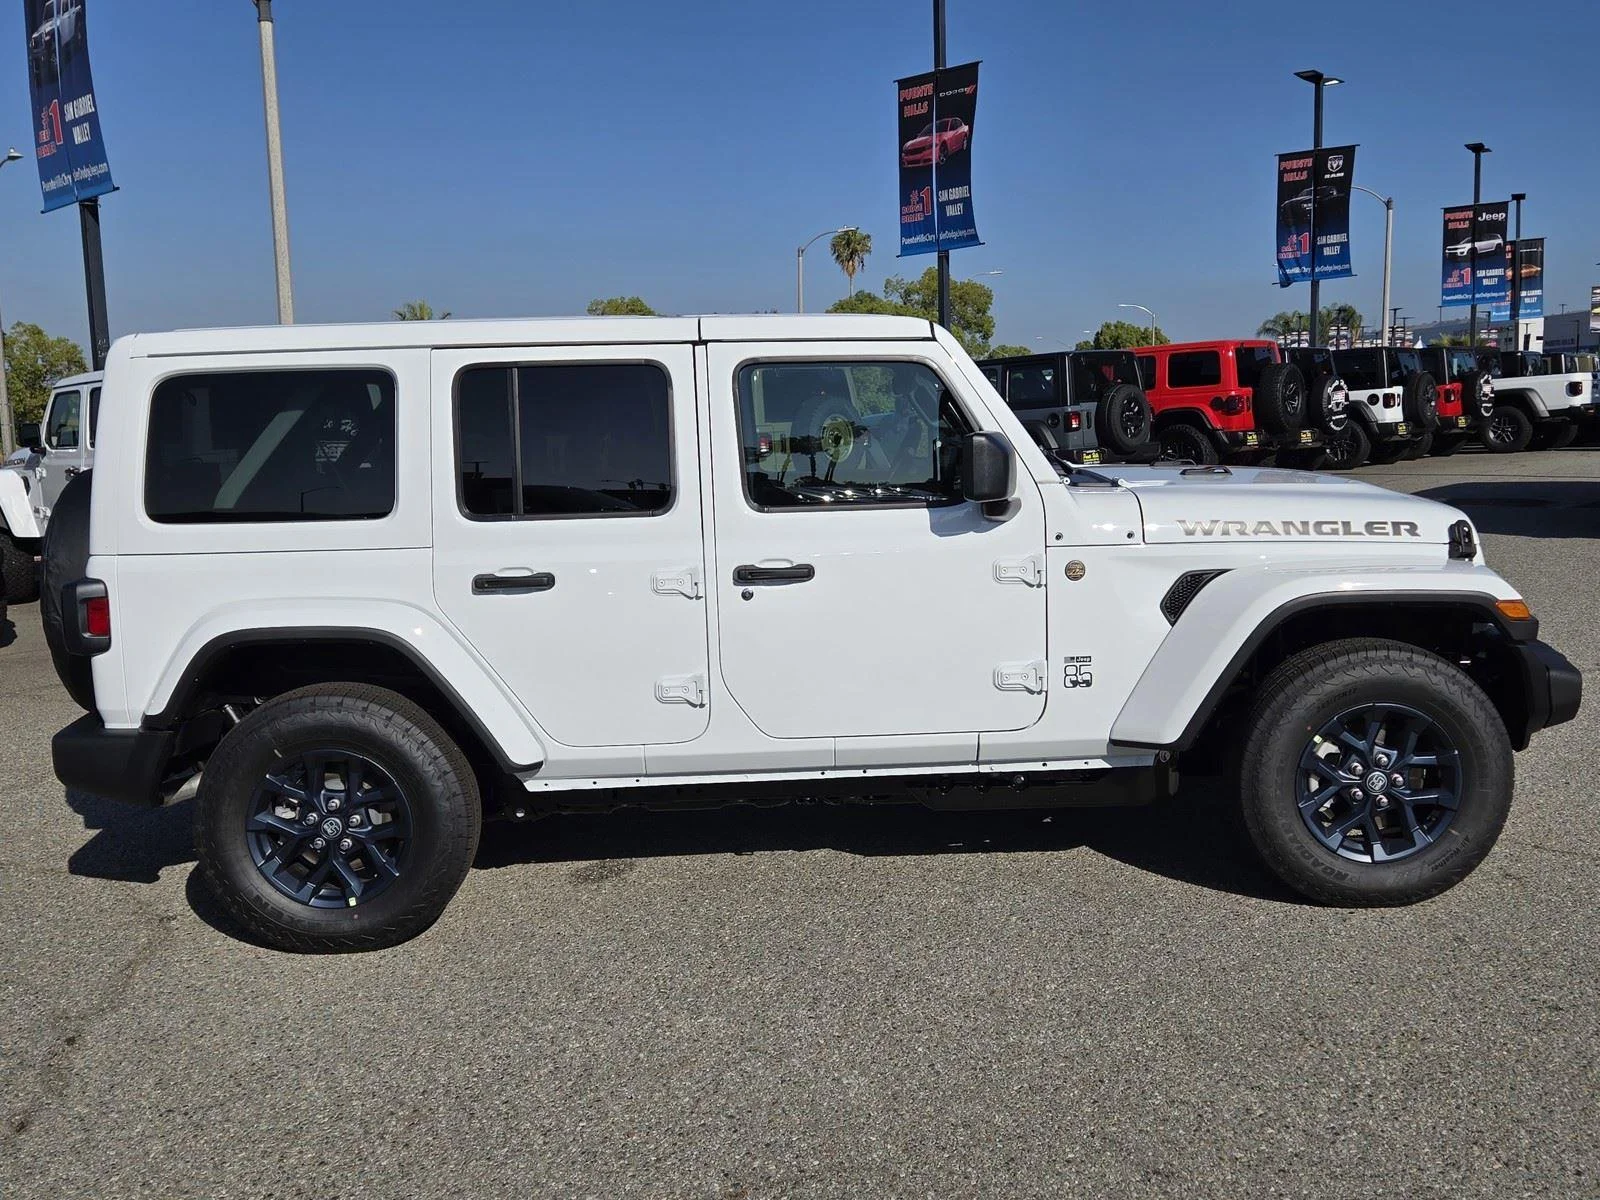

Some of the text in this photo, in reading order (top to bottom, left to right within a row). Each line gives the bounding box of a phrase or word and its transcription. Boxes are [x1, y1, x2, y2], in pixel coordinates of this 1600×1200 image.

[900, 83, 934, 101] PUENTE
[64, 102, 75, 121] SAN
[904, 101, 929, 118] HILLS
[73, 122, 91, 145] VALLEY
[938, 186, 970, 202] SAN GABRIEL
[945, 203, 963, 217] VALLEY
[1477, 211, 1506, 221] Jeep
[1177, 519, 1421, 538] WRANGLER
[1064, 664, 1092, 688] 85
